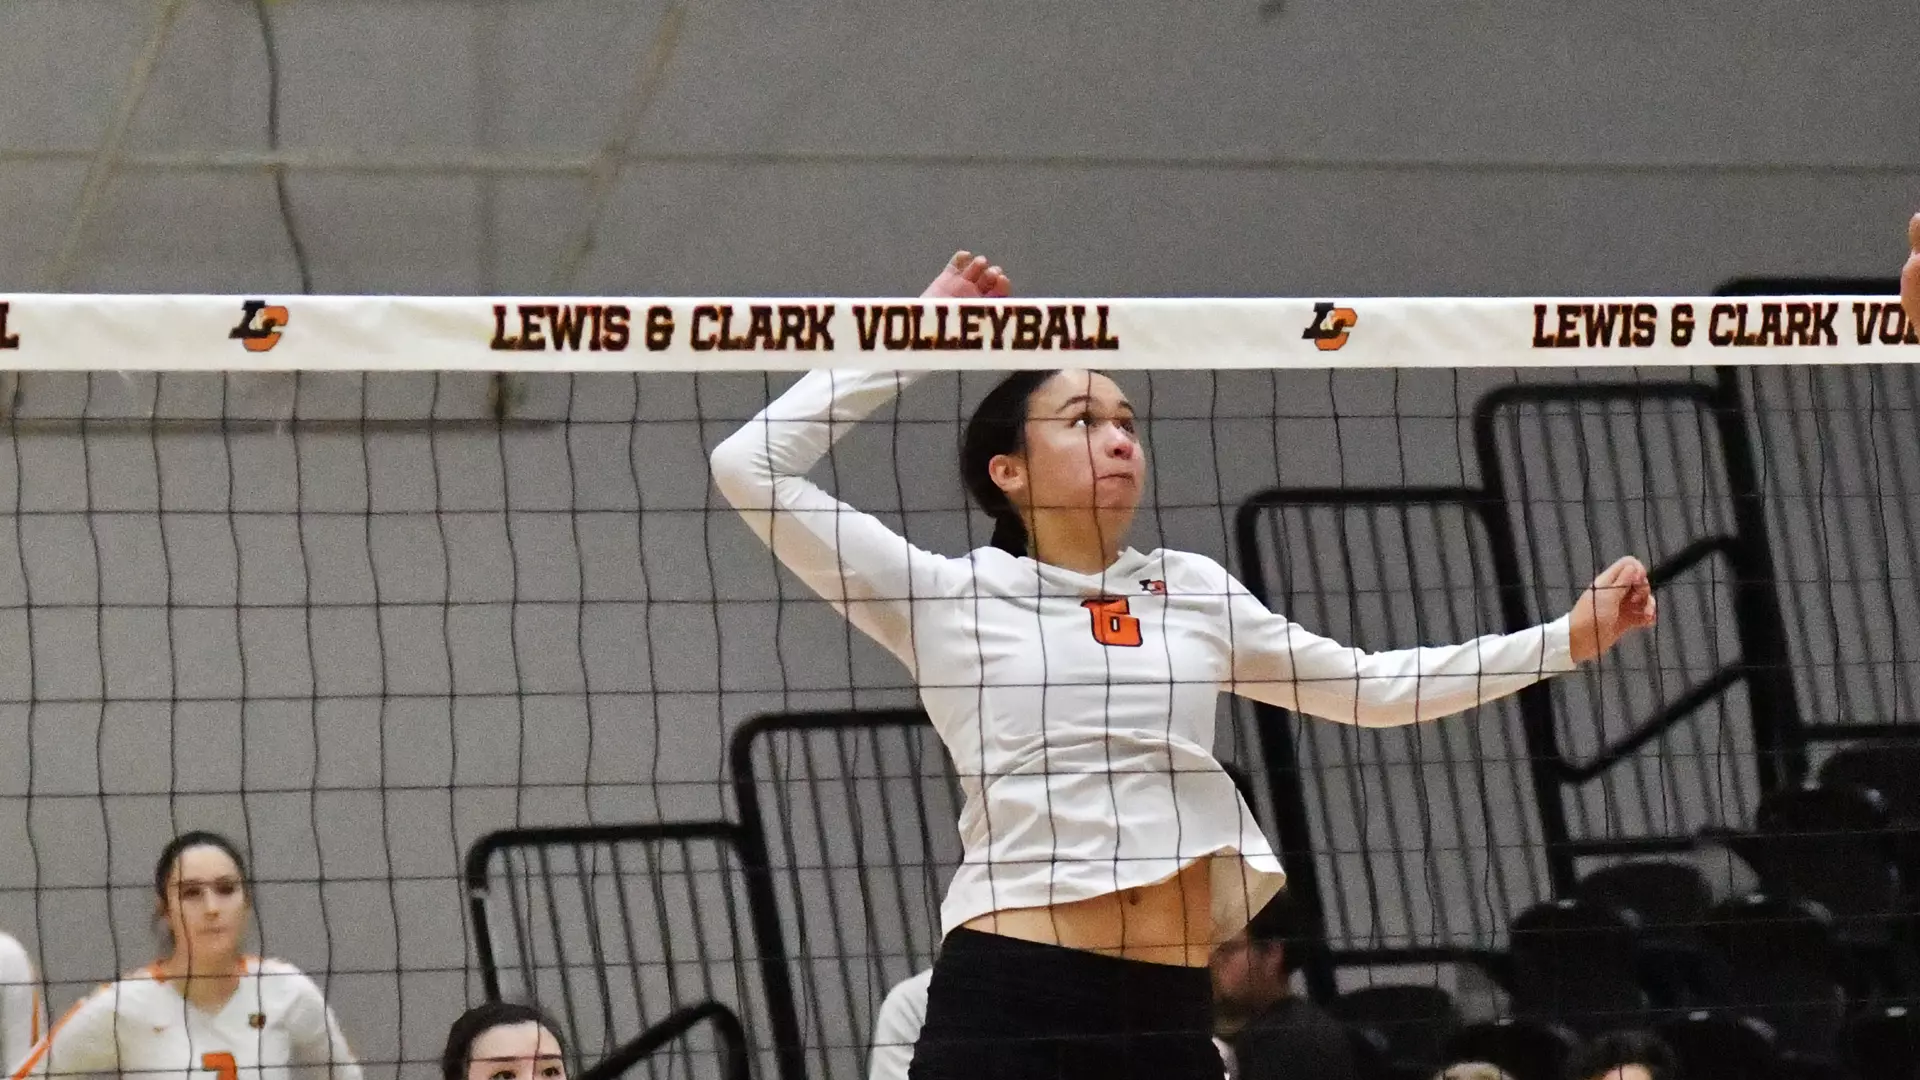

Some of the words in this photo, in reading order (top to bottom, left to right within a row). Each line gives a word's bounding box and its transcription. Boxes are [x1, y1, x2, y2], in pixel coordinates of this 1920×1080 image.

[490, 304, 631, 352] LEWIS
[645, 305, 675, 352] &
[690, 304, 835, 351] CLARK
[852, 304, 1119, 351] VOLLEYBALL
[1533, 303, 1657, 349] LEWIS
[1671, 304, 1695, 348] &
[1709, 303, 1838, 347] CLARK
